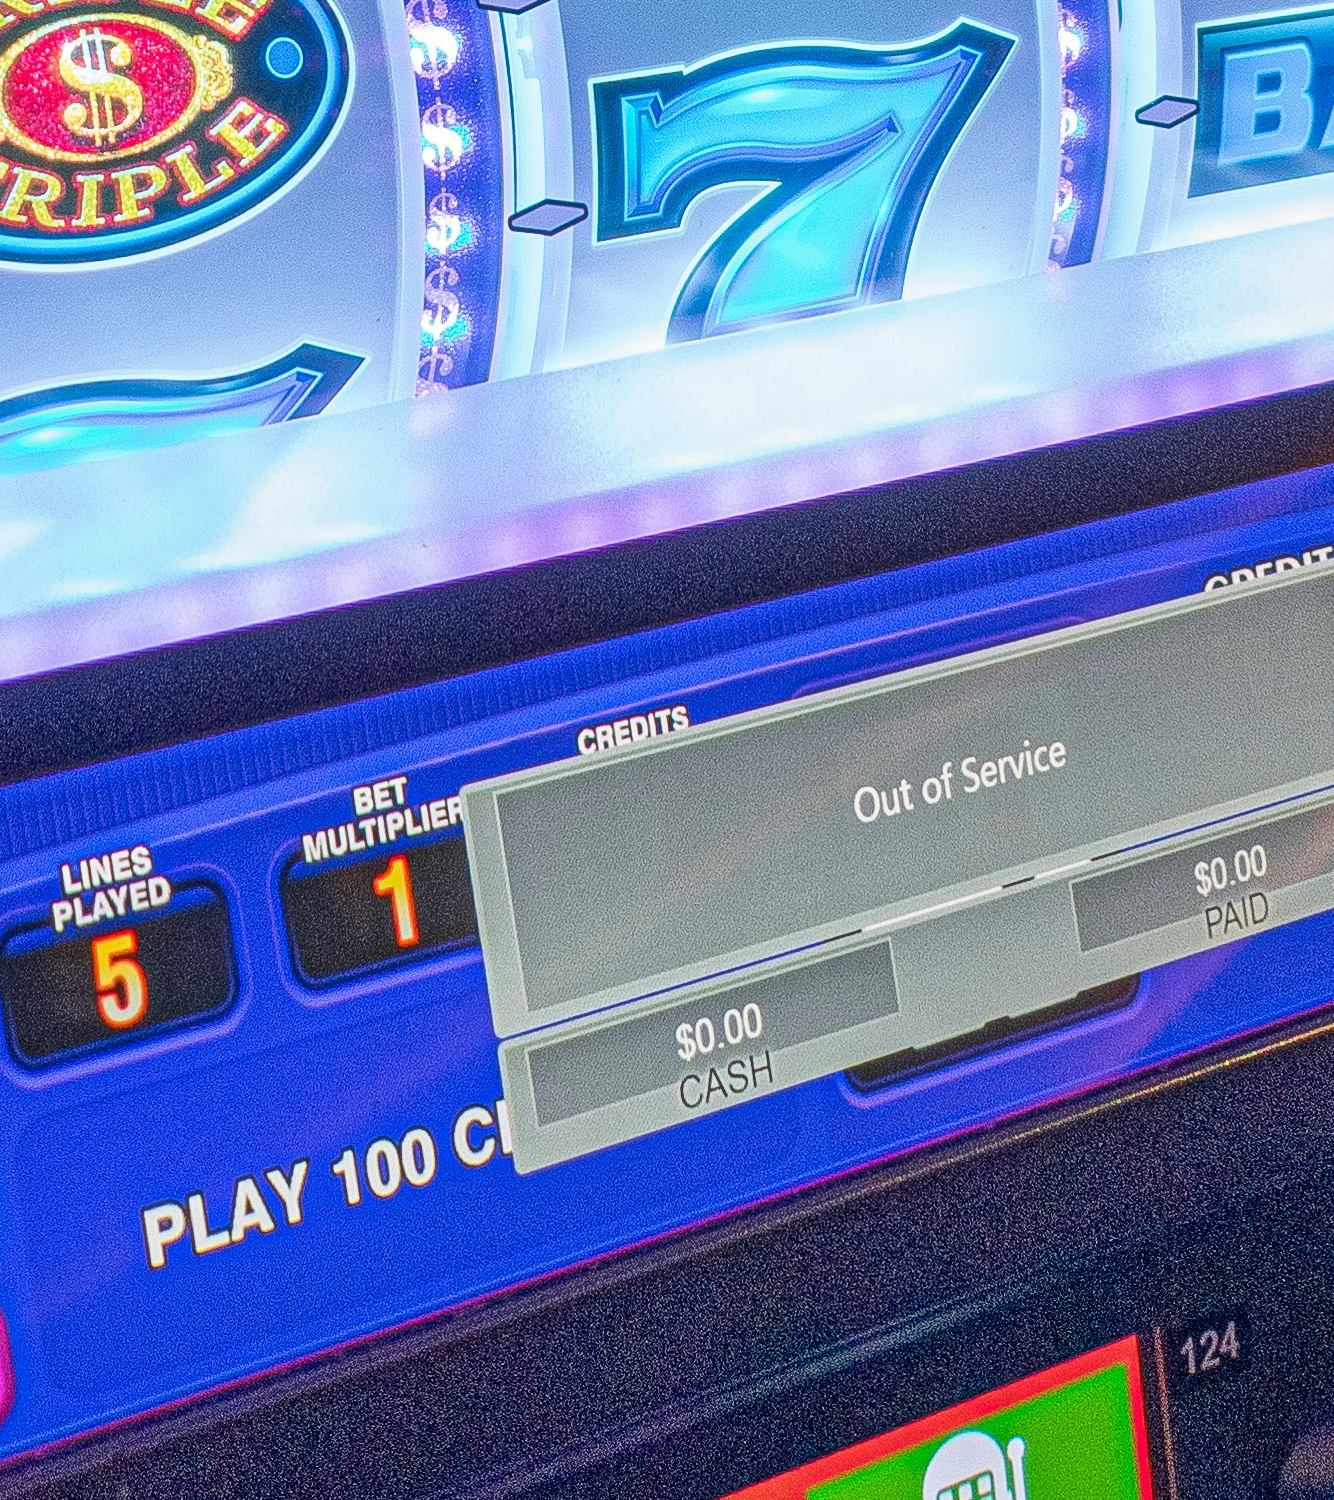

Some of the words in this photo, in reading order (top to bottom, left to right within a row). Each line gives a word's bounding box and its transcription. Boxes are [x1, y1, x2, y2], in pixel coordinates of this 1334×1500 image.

[590, 17, 1019, 345] 7
[577, 706, 690, 755] CREDITS
[353, 777, 407, 815] BET
[853, 782, 913, 825] Out
[924, 765, 955, 805] of
[961, 739, 1067, 792] Service
[302, 797, 464, 863] MULTIPLIER
[61, 847, 152, 895] LINES
[1195, 844, 1267, 897] $0.00
[52, 878, 172, 931] PLAYED
[374, 855, 419, 948] 1
[1205, 891, 1269, 940] PAID
[91, 931, 149, 1030] 5
[675, 1003, 763, 1061] $0.00
[678, 1050, 774, 1111] CASH
[142, 1163, 308, 1269] PLAY
[332, 1128, 436, 1207] 100
[1180, 1322, 1240, 1376] 124
